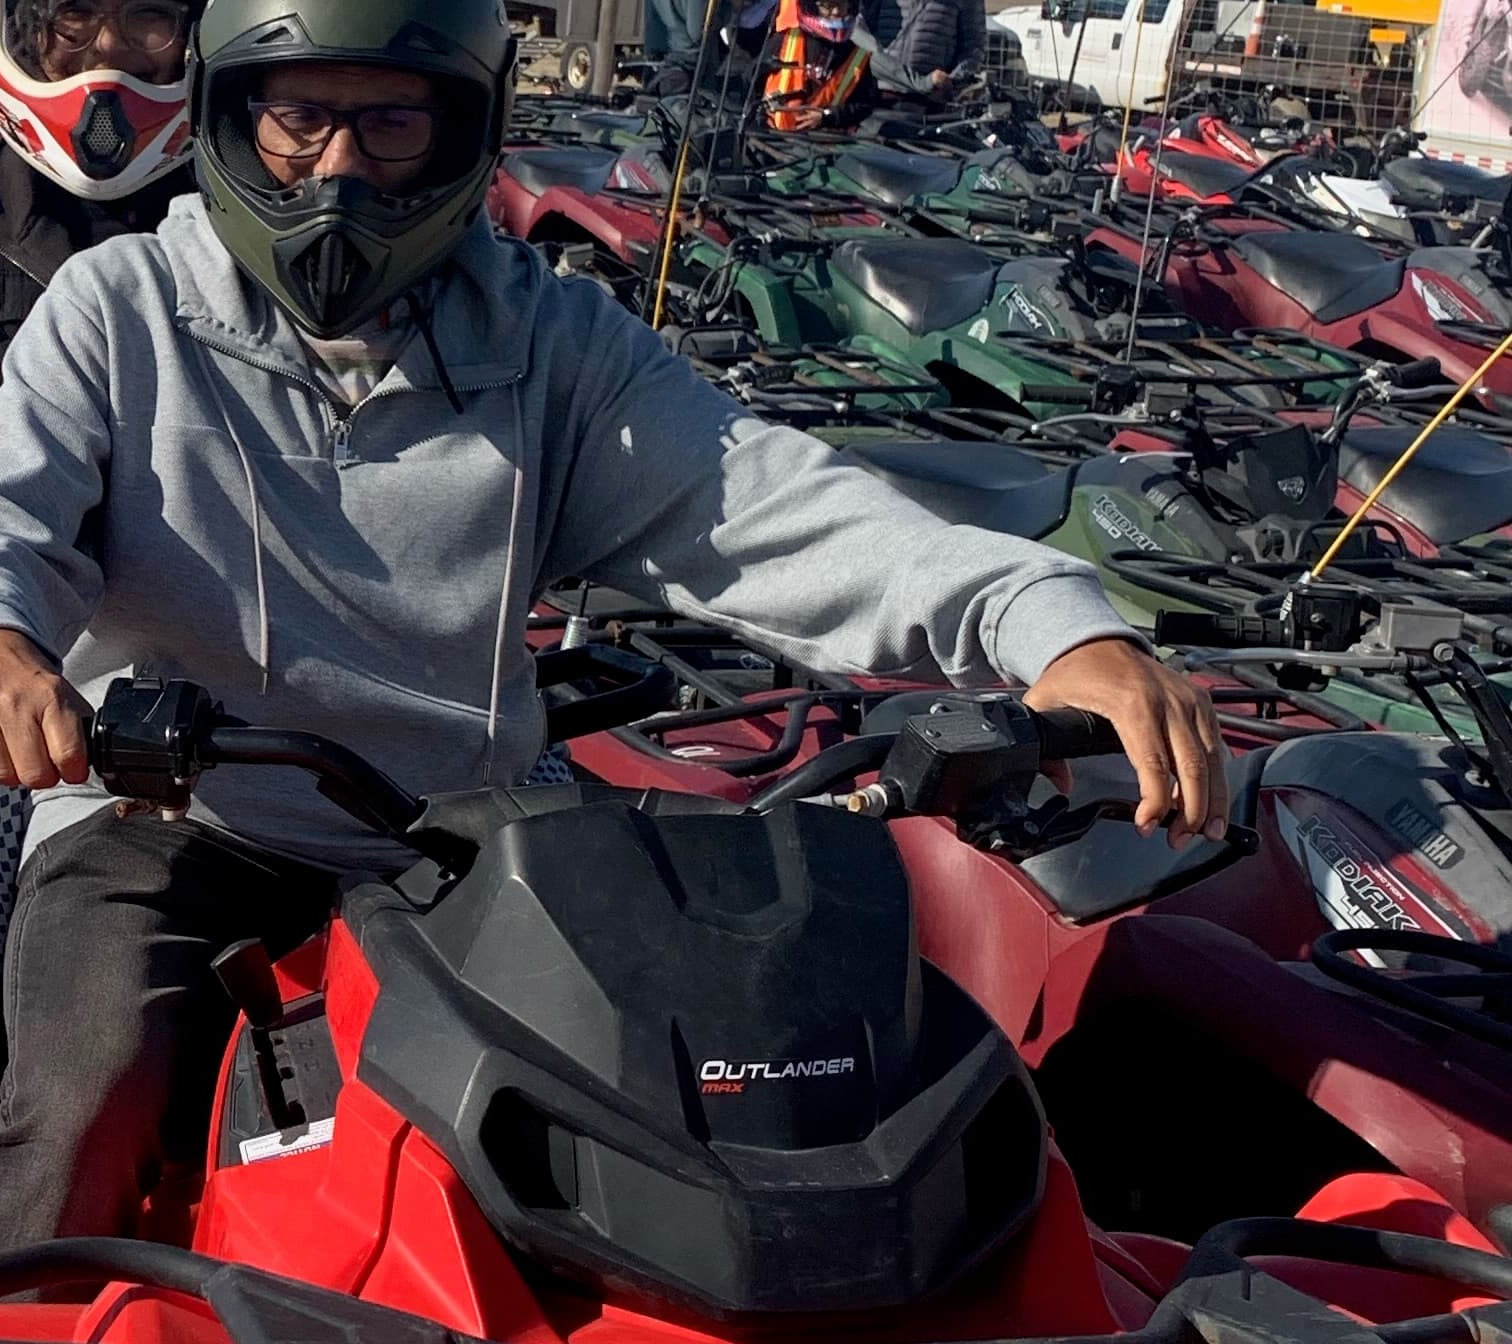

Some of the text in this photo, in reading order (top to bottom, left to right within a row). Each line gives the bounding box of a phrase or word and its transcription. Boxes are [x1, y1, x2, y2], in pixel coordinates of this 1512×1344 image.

[1392, 803, 1459, 867] YAMAHA
[1296, 811, 1422, 931] KODIAK
[1340, 894, 1381, 929] 45
[700, 1056, 856, 1081] OUTLANDER
